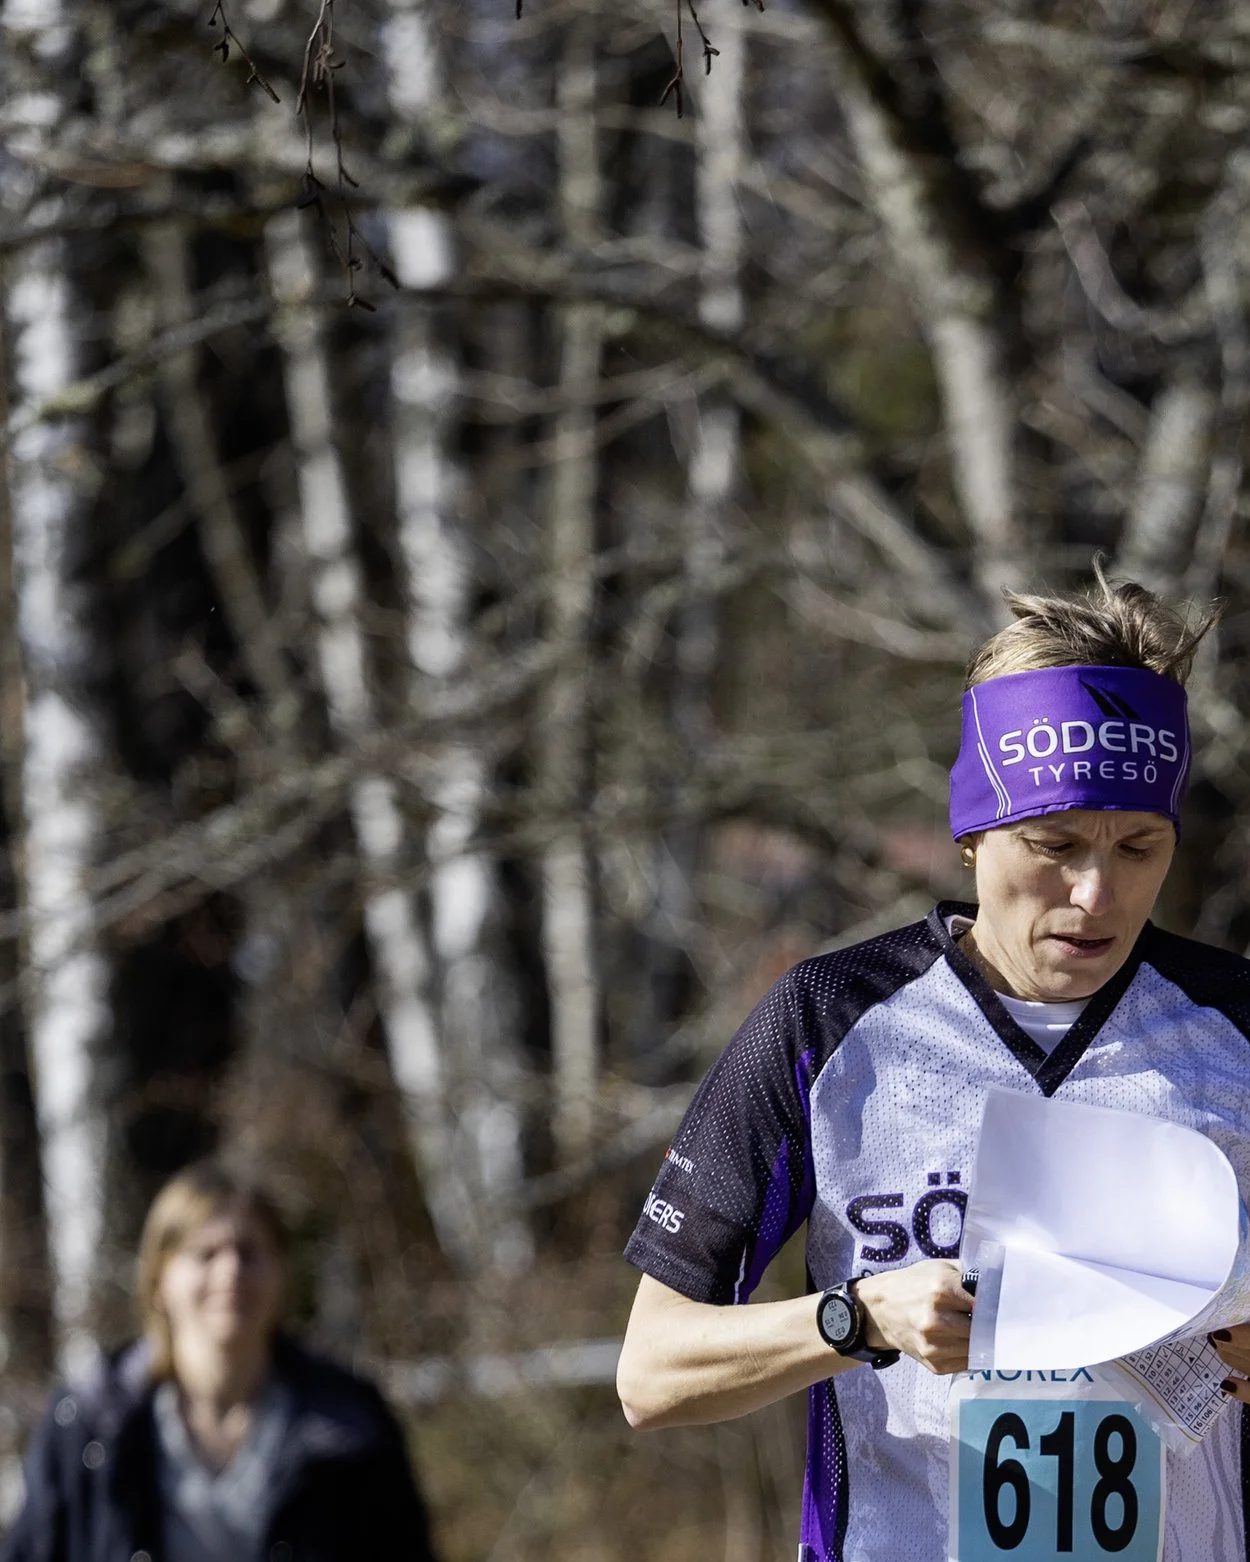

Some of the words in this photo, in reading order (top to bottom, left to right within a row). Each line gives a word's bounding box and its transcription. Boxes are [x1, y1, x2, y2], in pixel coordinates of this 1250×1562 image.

[999, 716, 1178, 767] SÖDERS
[1028, 760, 1158, 786] TYRESÖ
[1148, 1370, 1157, 1380] 10
[1156, 1379, 1164, 1389] 11
[1163, 1387, 1172, 1397] 12
[1170, 1396, 1178, 1405] 13
[1177, 1404, 1186, 1414] 14
[1185, 1412, 1194, 1422] 15
[1193, 1421, 1203, 1431] 16
[1202, 1408, 1213, 1421] 106
[983, 1411, 1139, 1553] 618
